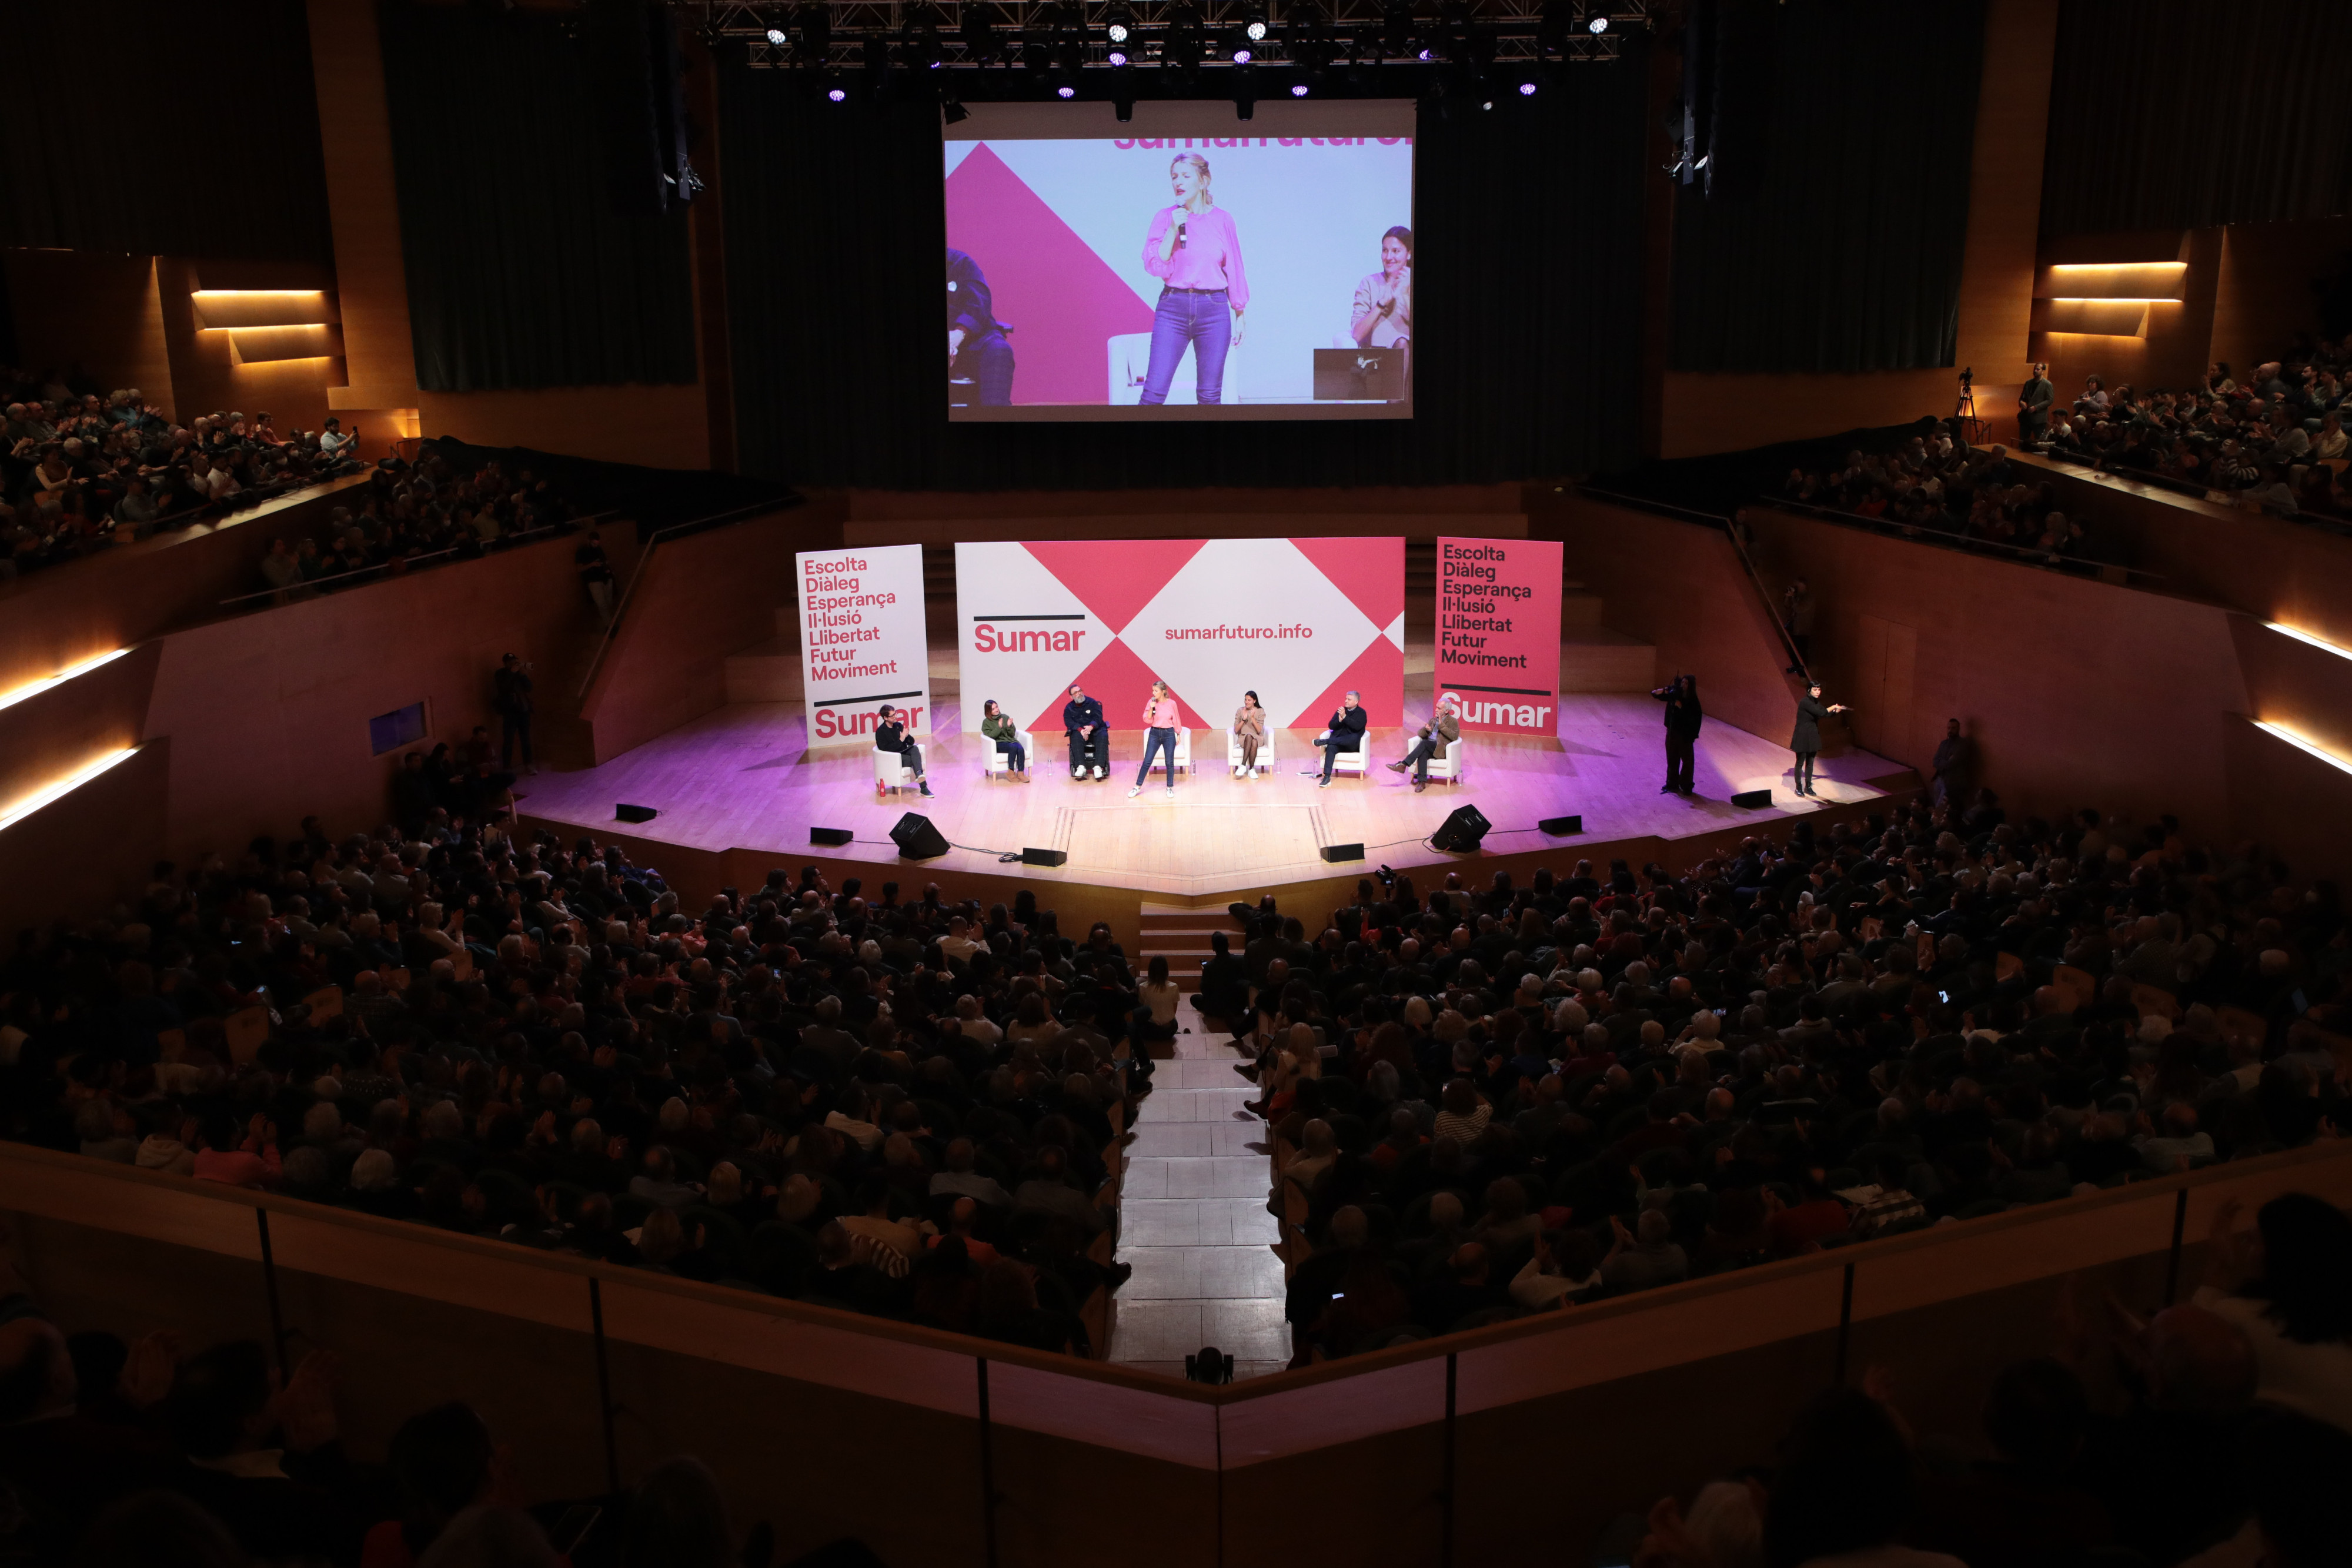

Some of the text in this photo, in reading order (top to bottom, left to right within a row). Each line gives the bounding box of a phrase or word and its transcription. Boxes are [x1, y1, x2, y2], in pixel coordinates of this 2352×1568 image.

[1444, 544, 1505, 561] Escolta
[804, 557, 867, 575] Escolta
[1444, 561, 1496, 583] Diàleg
[806, 576, 860, 593] Diàleg
[1444, 579, 1531, 601] Esperança
[807, 593, 896, 613] Esperança
[1443, 596, 1495, 614] Il·lusió
[808, 610, 862, 628] Il·lusió
[1442, 614, 1512, 633] Llibertat
[810, 627, 880, 646] Llibertat
[975, 624, 1086, 653] Sumar
[1165, 623, 1312, 640] sumarfuturo.info
[1442, 631, 1487, 648] Futur
[811, 648, 857, 664] Futur
[1441, 648, 1527, 668] Moviment
[812, 660, 897, 681] Moviment
[1441, 691, 1551, 728] Sumar
